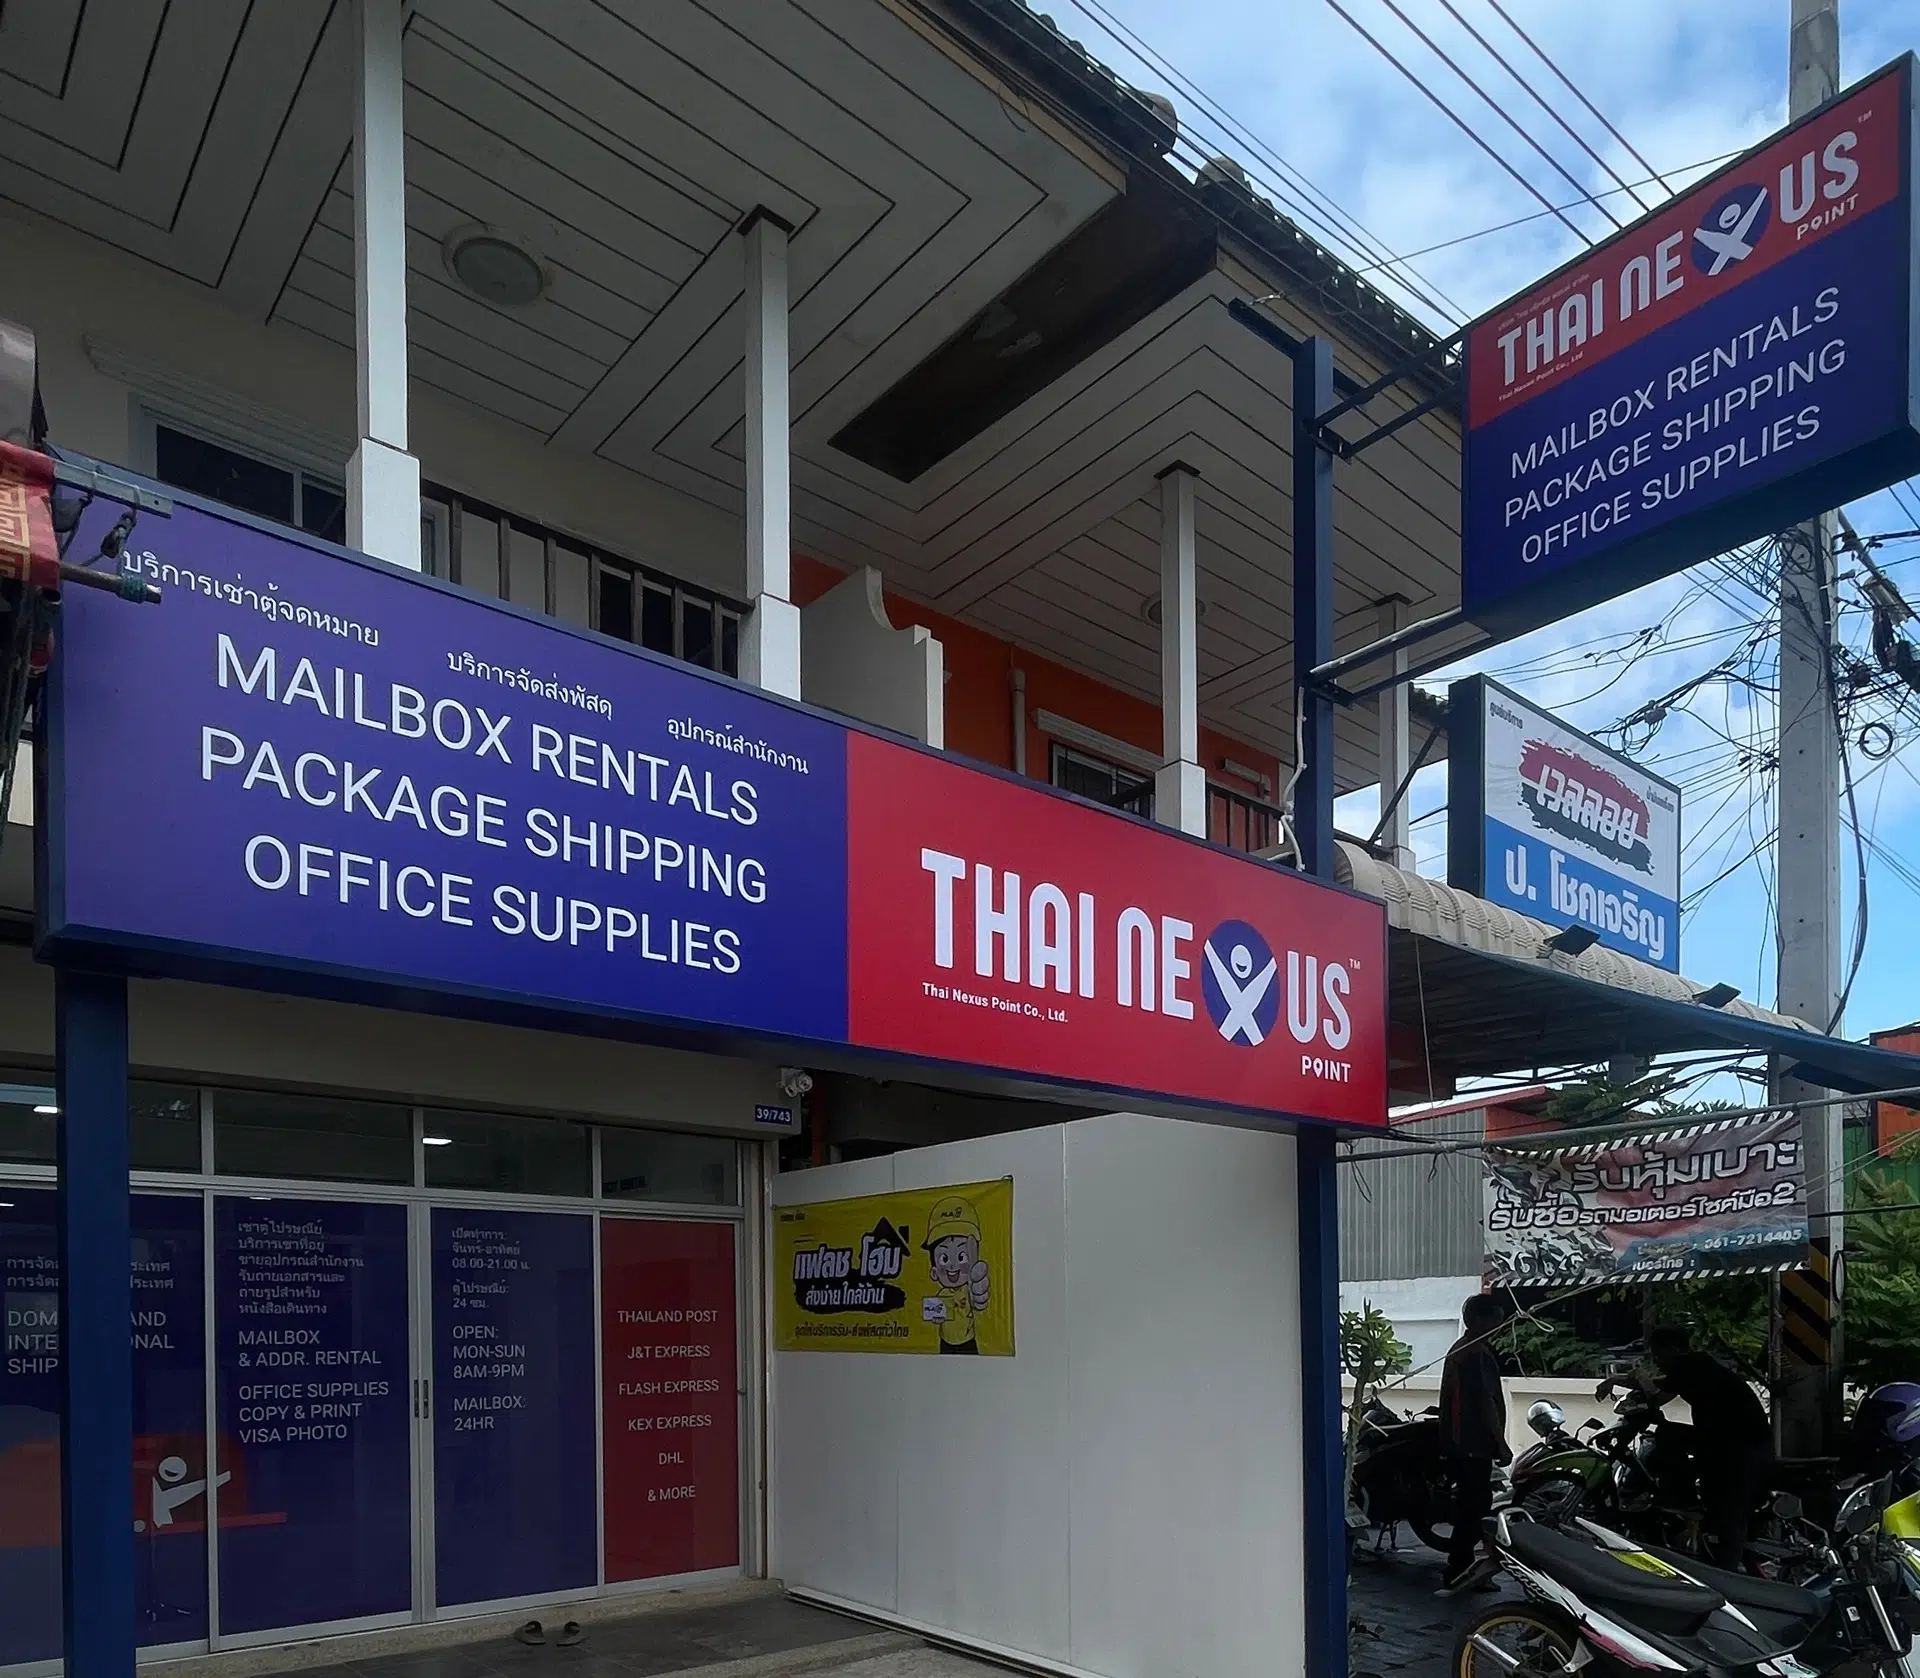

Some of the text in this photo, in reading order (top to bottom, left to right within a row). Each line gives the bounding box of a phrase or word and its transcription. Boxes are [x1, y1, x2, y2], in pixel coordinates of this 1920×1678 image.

[1797, 194, 1859, 240] POINT
[1497, 279, 1603, 387] THAI
[1512, 380, 1654, 478] MAILBOX
[1666, 286, 1839, 400] RENTALS
[1499, 389, 1512, 402] Thai
[1505, 339, 1846, 527] PACKAGE SHIPPING
[1521, 405, 1820, 564] OFFICE SUPPLIES
[123, 549, 380, 647] บริการเช่าตู้จดหมาย
[447, 650, 612, 722] บริการจัดส่งพัสดุ
[216, 633, 758, 827] MAILBOX RENTALS
[666, 718, 809, 775] อุปกรณ์สำนักงาน
[201, 726, 767, 905] PACKAGE SHIPPING
[244, 834, 741, 975] OFFICE SUPPLIES
[1505, 845, 1665, 961] ป. โชคเจริญ
[921, 847, 1095, 998] THAI
[923, 982, 1069, 1023] Thai Nexus Point Co., Ltd.
[1301, 1054, 1352, 1083] POINT
[756, 1107, 791, 1123] 39/743
[452, 1297, 467, 1309] 24
[618, 1309, 719, 1324] THAILAND POST
[238, 1330, 320, 1346] MAILBOX
[452, 1325, 499, 1341] OPEN:
[238, 1350, 382, 1367] & ADDR. RENTAL
[452, 1344, 526, 1360] MON-SUN
[627, 1344, 711, 1360] J&T EXPRESS
[453, 1364, 525, 1380] 8AM-9PM
[239, 1381, 389, 1400] OFFICE SUPPLIES
[619, 1379, 719, 1395] FLASH EXPRESS
[239, 1403, 362, 1422] COPY & PRINT
[453, 1395, 526, 1412] MAILBOX:
[454, 1416, 495, 1432] 24HR
[628, 1414, 712, 1431] KEX EXPRESS
[239, 1425, 347, 1444] VISA PHOTO
[659, 1451, 684, 1465] DHL
[648, 1485, 696, 1502] & MORE
